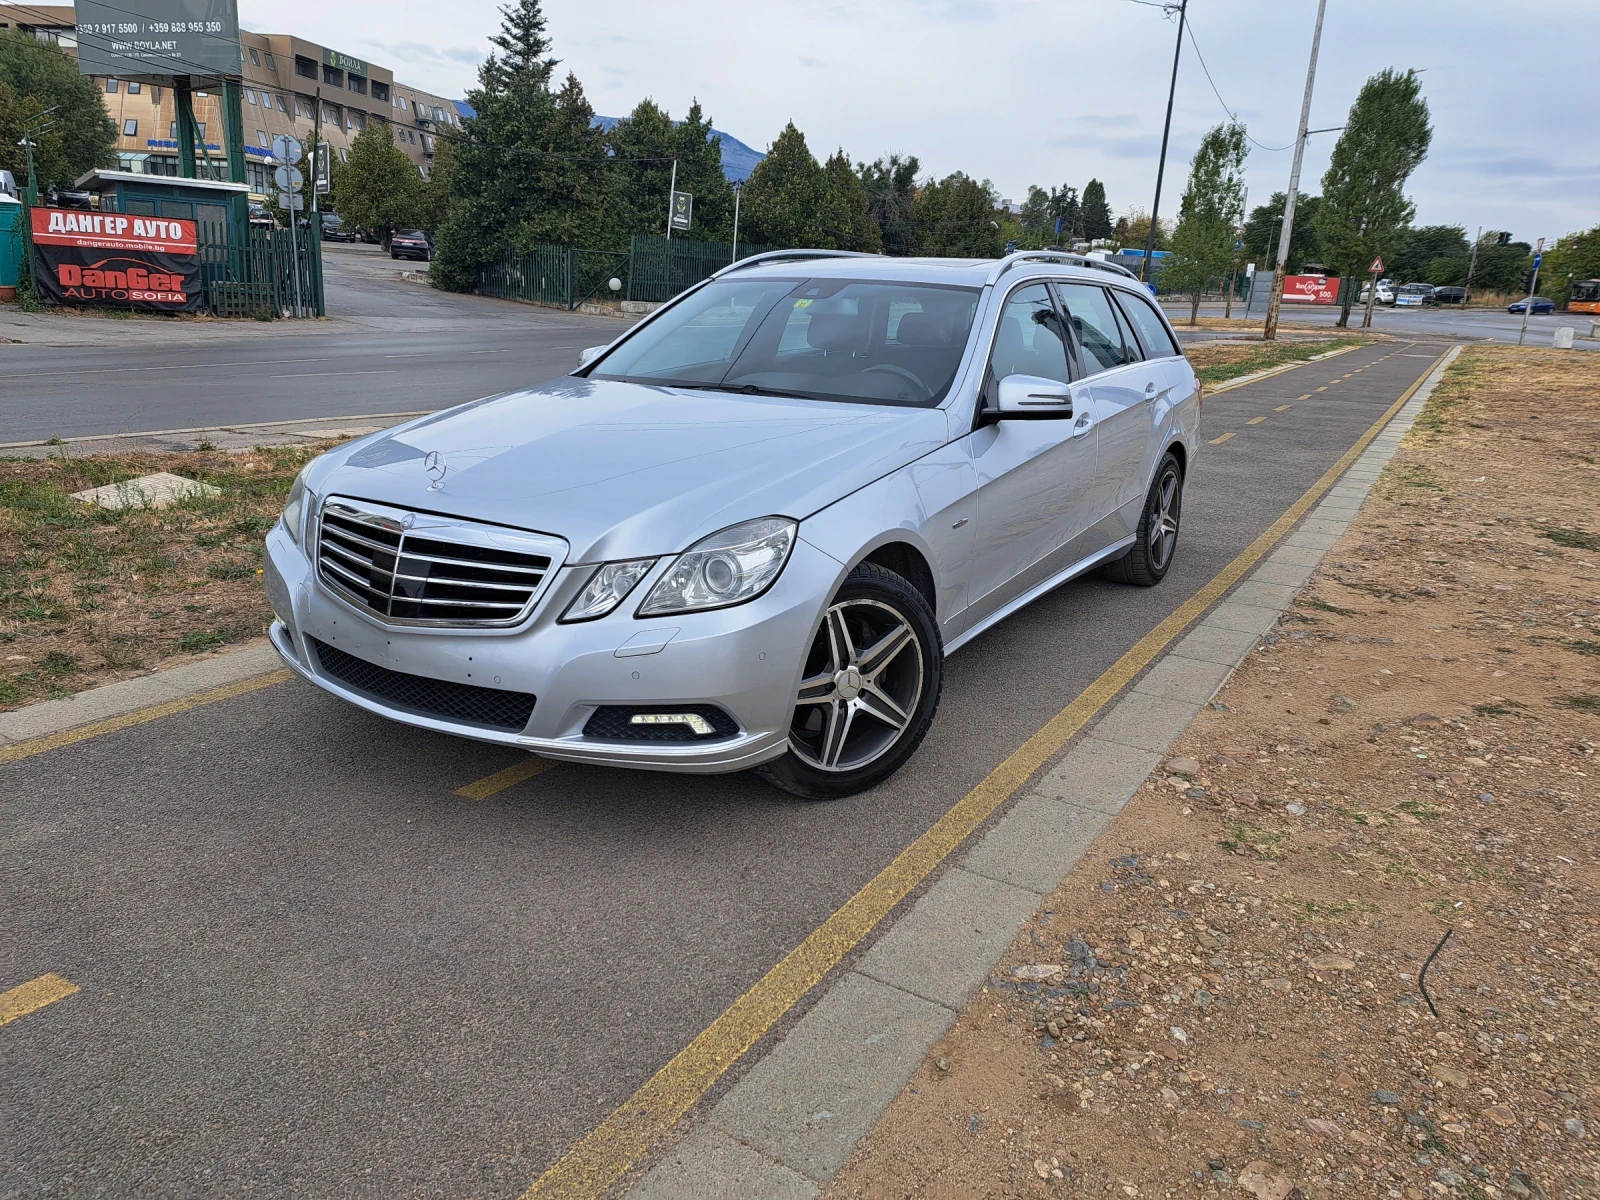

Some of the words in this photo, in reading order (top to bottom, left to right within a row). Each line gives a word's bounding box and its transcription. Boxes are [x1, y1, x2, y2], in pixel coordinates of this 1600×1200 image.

[95, 23, 100, 33] 2
[101, 23, 116, 33] 917
[118, 23, 138, 33] 5500
[149, 22, 169, 33] +359
[188, 22, 204, 32] 955
[206, 21, 221, 32] 350
[48, 211, 128, 235] ДАНГЕР
[133, 218, 182, 240] АУТО
[76, 239, 165, 252] dangerauto.mobile.bg
[58, 263, 185, 292] DanGer
[61, 287, 128, 300] AUTO
[131, 291, 185, 302] SOFIA
